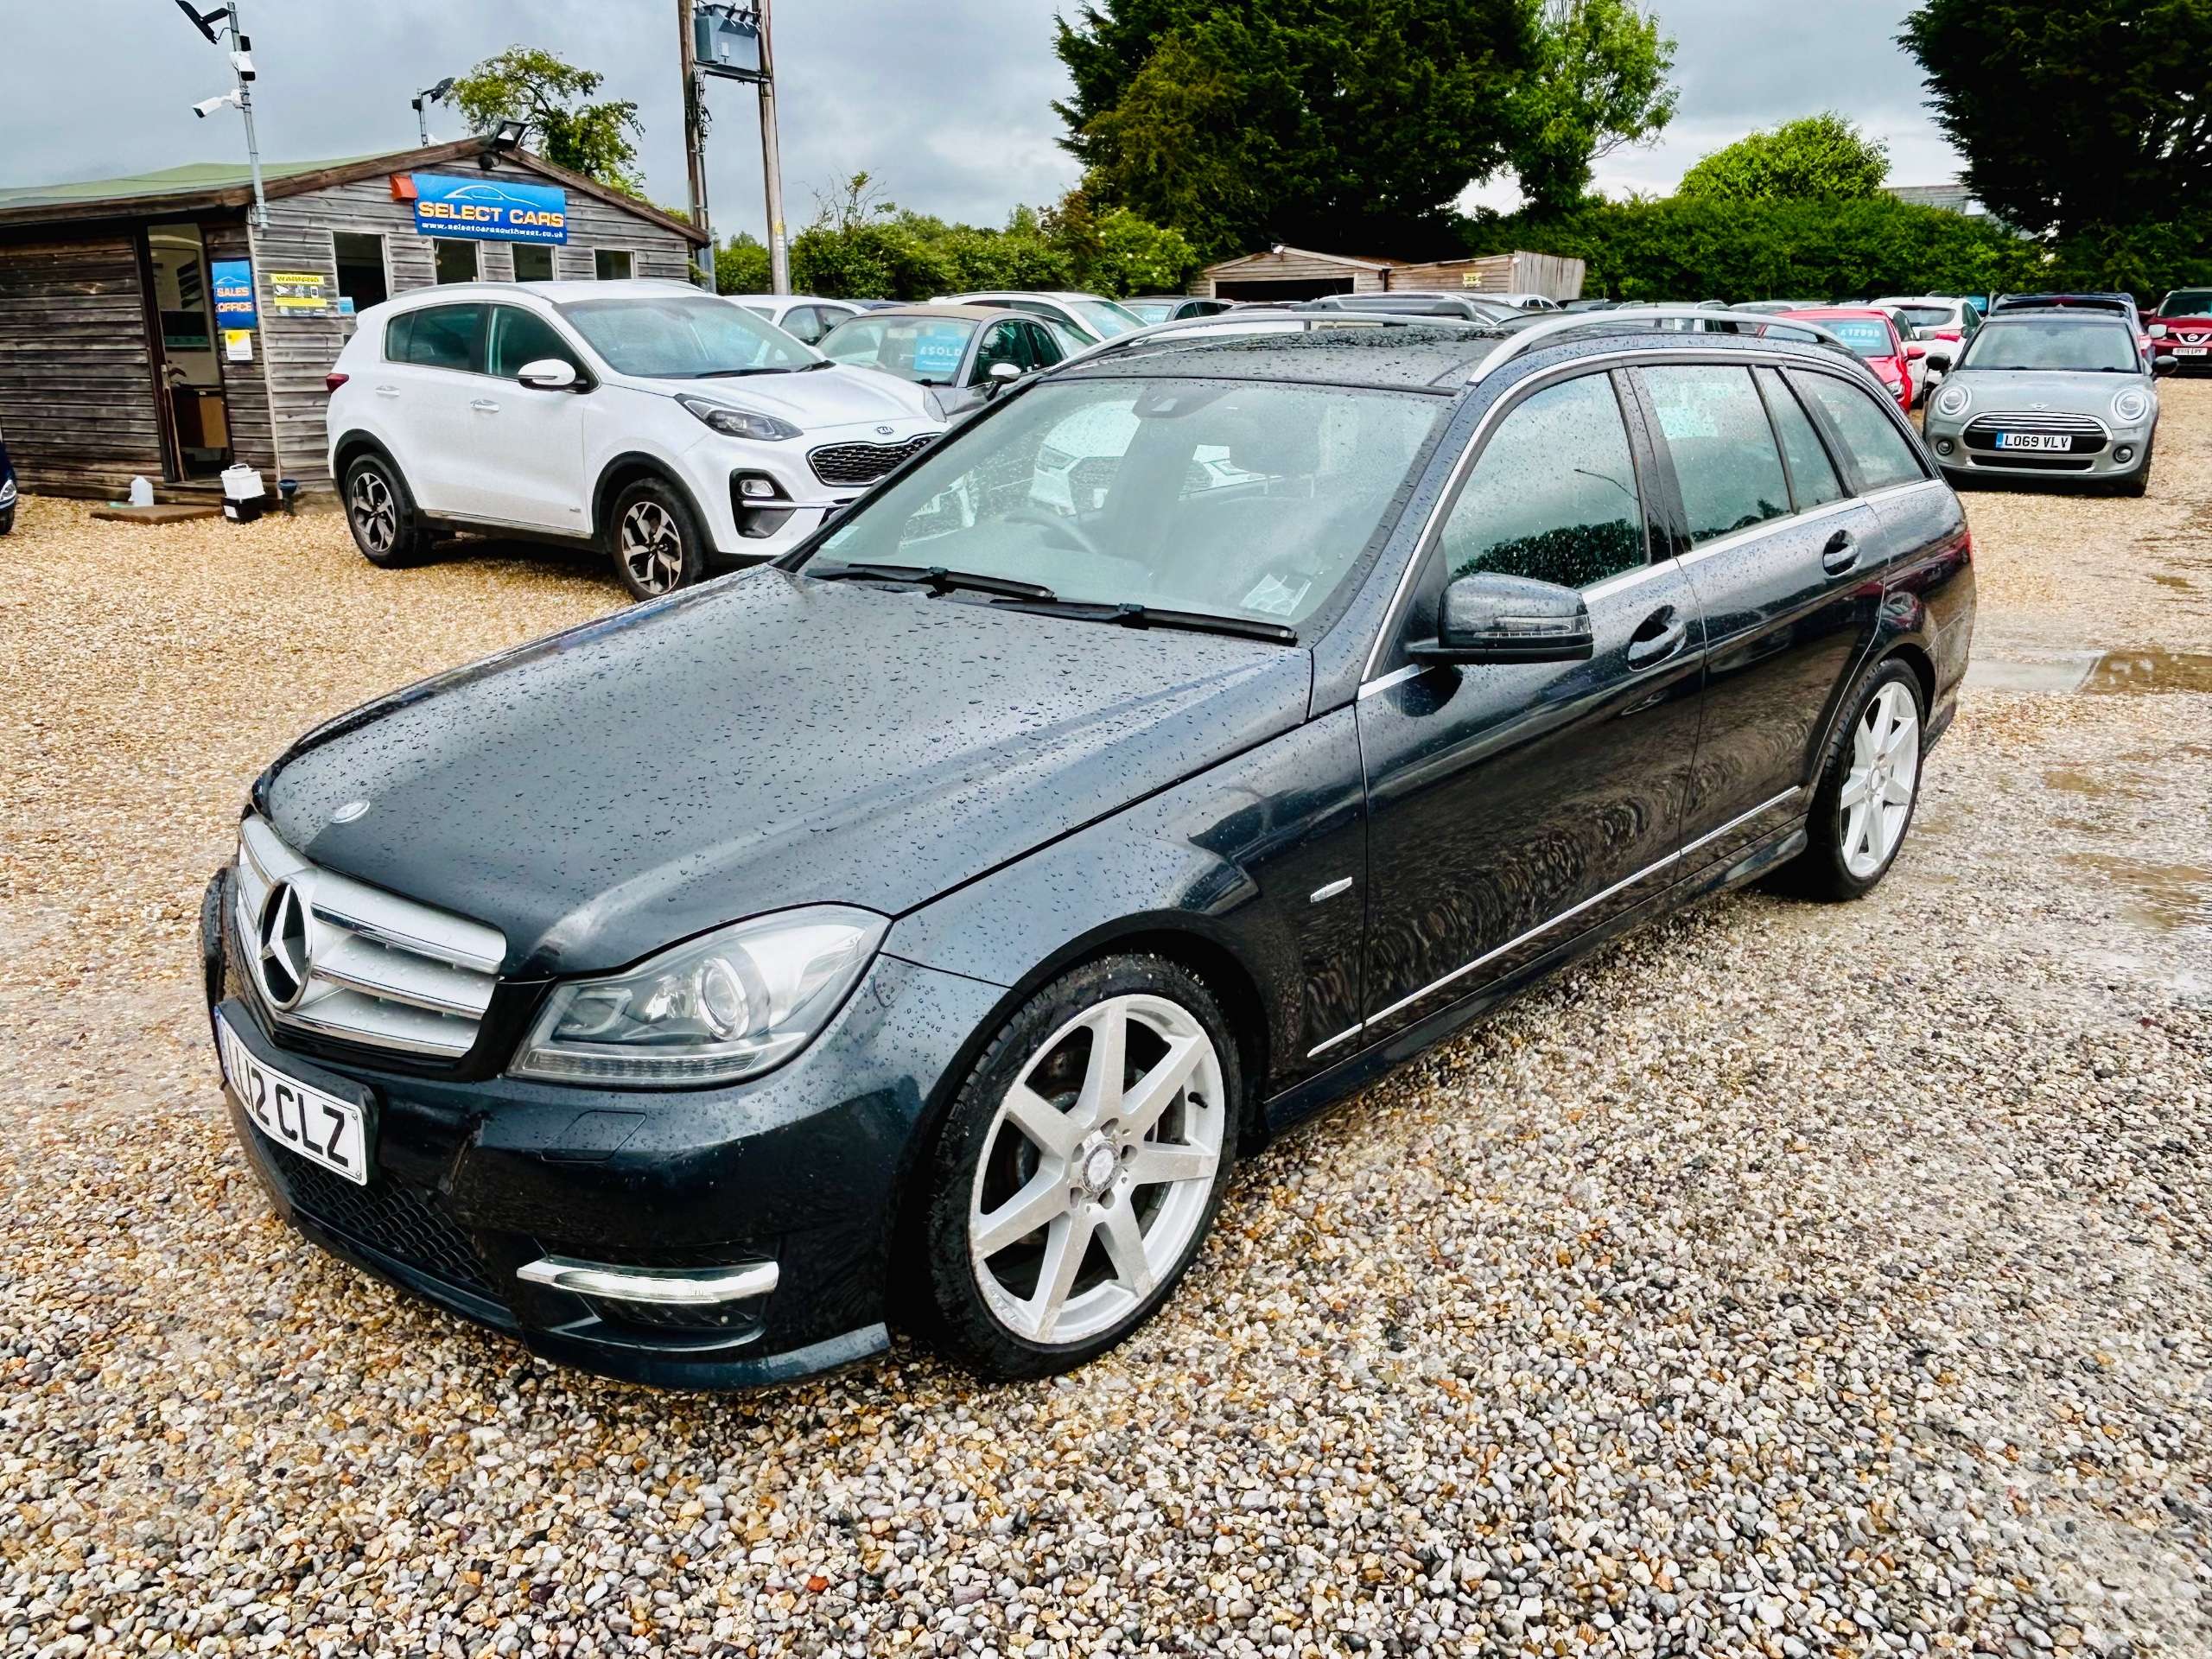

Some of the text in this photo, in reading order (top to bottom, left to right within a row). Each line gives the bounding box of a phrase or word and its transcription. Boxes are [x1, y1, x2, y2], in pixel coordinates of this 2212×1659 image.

[418, 201, 564, 228] SELECT CARS
[217, 287, 250, 297] SALES
[216, 302, 252, 312] OFFICE
[2005, 435, 2039, 448] LO69
[275, 1084, 349, 1168] CLZ
